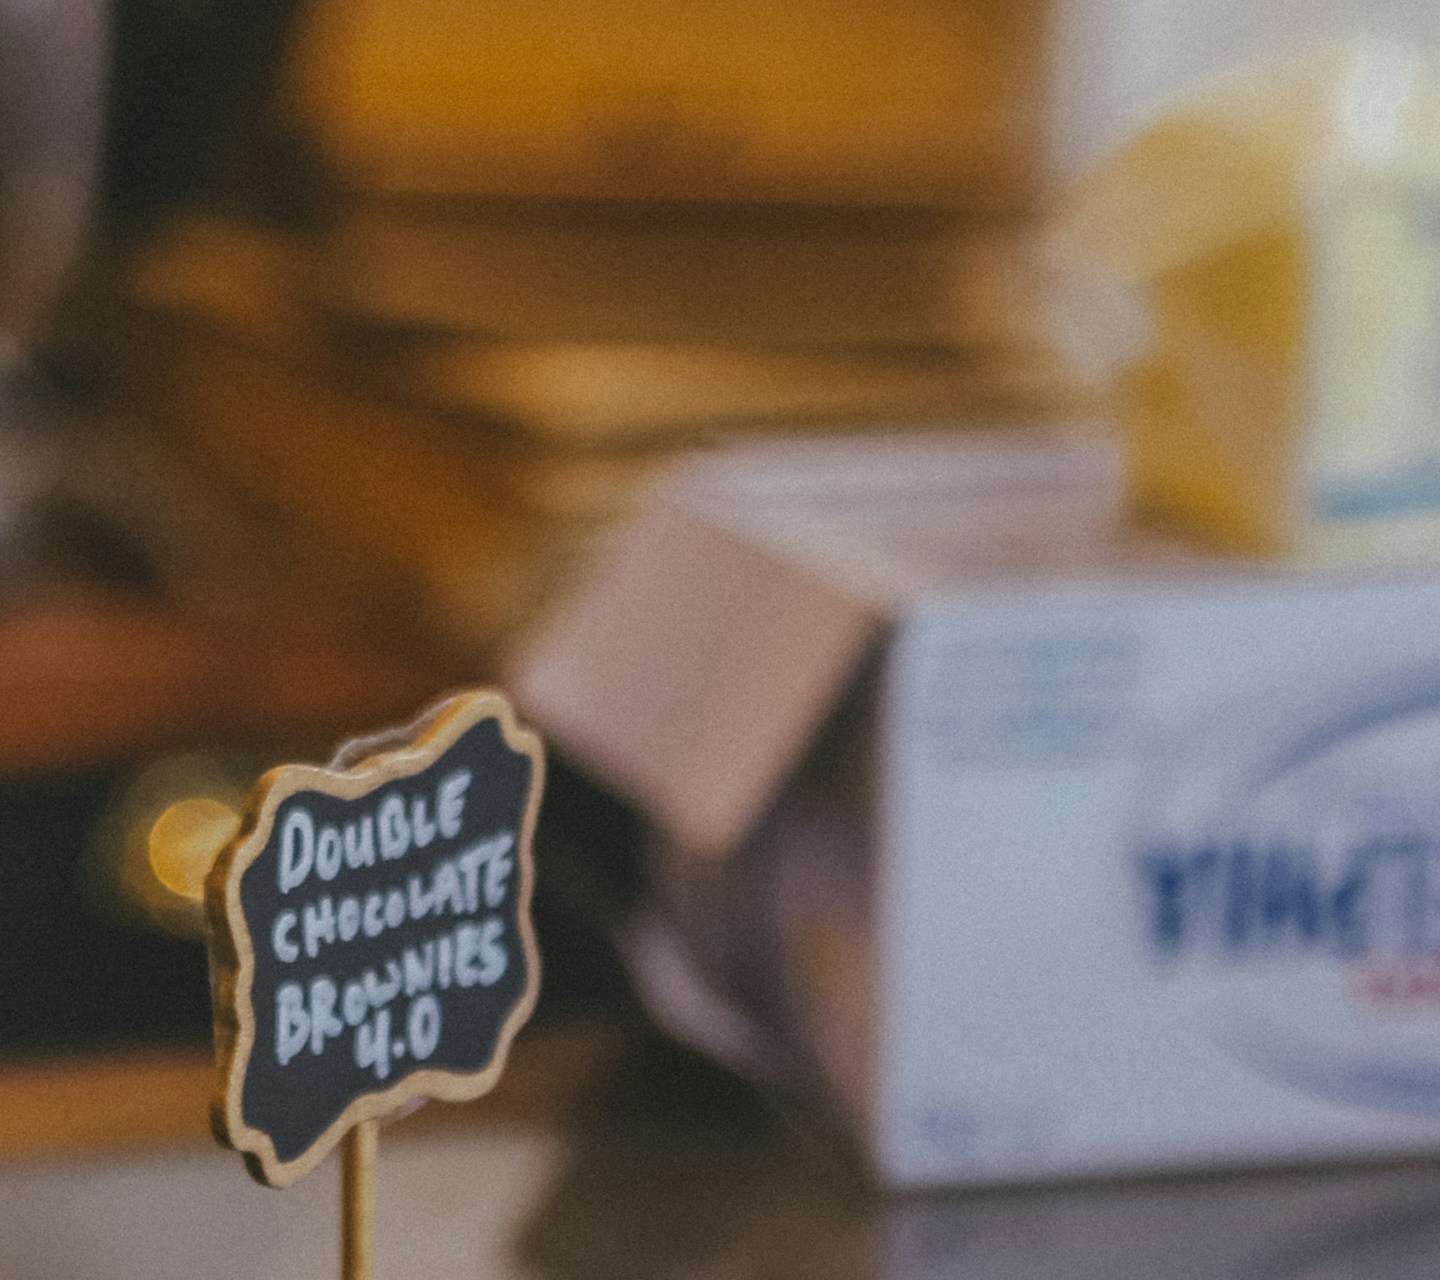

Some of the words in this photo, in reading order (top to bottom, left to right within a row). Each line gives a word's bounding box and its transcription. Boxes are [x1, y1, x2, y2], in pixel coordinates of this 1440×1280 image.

[279, 770, 472, 894] DOUBLE
[270, 830, 515, 963] CHOCOLATE
[273, 918, 508, 1066] BROWNIES
[355, 993, 443, 1080] 4.0
